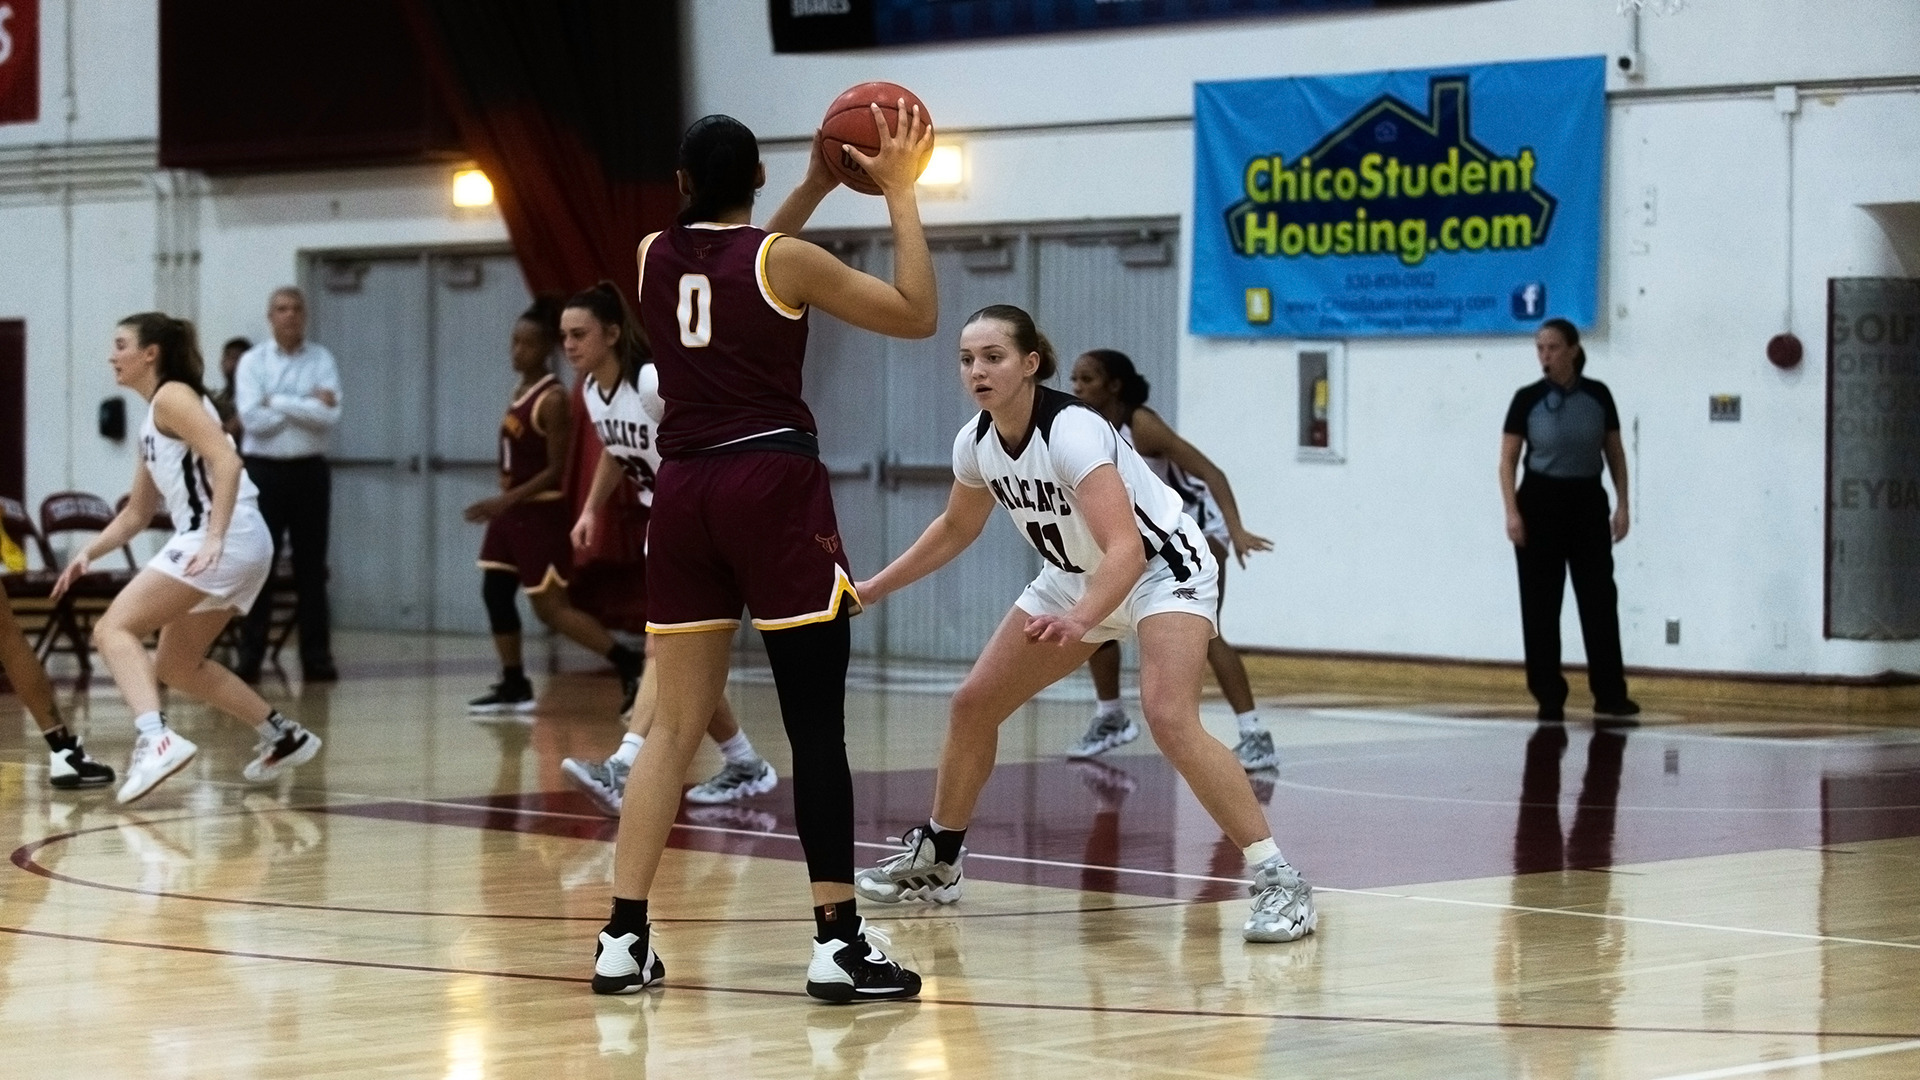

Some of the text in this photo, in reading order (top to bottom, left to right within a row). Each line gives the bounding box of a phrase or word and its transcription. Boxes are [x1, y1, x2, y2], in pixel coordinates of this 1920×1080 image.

[1245, 147, 1535, 203] ChicoStudent
[1244, 206, 1534, 264] Housing.com
[676, 272, 712, 348] 0
